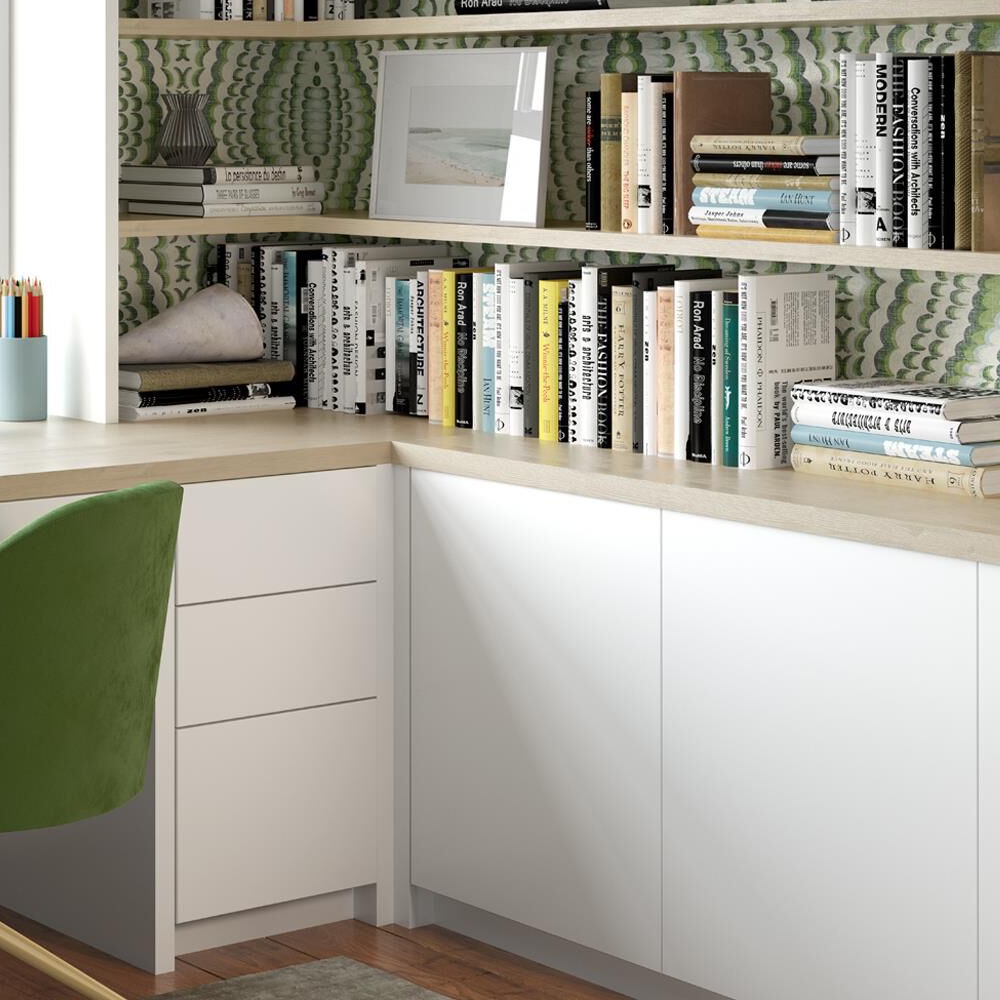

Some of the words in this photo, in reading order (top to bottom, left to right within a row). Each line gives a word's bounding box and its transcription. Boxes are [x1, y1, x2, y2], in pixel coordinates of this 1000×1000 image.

[892, 59, 904, 98] THE
[876, 64, 887, 137] MODERN
[910, 88, 920, 150] Conversations
[892, 104, 904, 184] FASHION
[586, 147, 594, 162] than
[910, 152, 920, 170] with
[586, 162, 594, 182] others
[733, 161, 750, 170] others
[751, 161, 764, 170] than
[699, 187, 758, 206] STEAM
[780, 193, 794, 205] IAN
[794, 193, 816, 206] HUNT
[910, 172, 920, 216] Architects
[876, 217, 887, 232] A
[892, 190, 904, 240] BOOK
[457, 281, 467, 301] Ron
[740, 282, 748, 290] IT'S
[740, 291, 748, 300] NOT
[308, 282, 317, 331] Conversations
[343, 306, 351, 320] arts
[457, 303, 467, 326] Arad
[598, 298, 607, 330] THE
[693, 300, 704, 321] Ron
[740, 300, 748, 310] HOW
[582, 315, 594, 332] arts
[740, 323, 748, 332] YOU
[308, 333, 317, 348] with
[693, 324, 704, 350] Arad
[740, 342, 748, 351] IT'S
[343, 332, 355, 376] architecture
[617, 324, 626, 370] HARRY
[740, 352, 748, 361] HOW
[308, 349, 317, 383] Architects
[456, 348, 467, 394] Discipline
[542, 343, 550, 403] Winnie-the-Pooh
[582, 346, 595, 400] architecture
[598, 333, 607, 398] FASHION
[692, 356, 705, 371] No
[483, 378, 492, 392] IAN
[740, 374, 748, 383] YOU
[617, 374, 626, 417] POTTER
[692, 374, 705, 424] Discipline
[740, 384, 748, 396] WANT
[483, 394, 492, 416] HUNT
[773, 401, 780, 410] by
[598, 402, 607, 443] BOOK
[740, 416, 748, 426] Paul
[832, 410, 881, 432] architecture
[894, 418, 912, 435] arts
[808, 434, 833, 446] HUNT
[833, 436, 851, 449] IAN
[883, 440, 961, 464] STEAM
[828, 463, 877, 478] POTTER
[884, 472, 936, 485] HARRY
